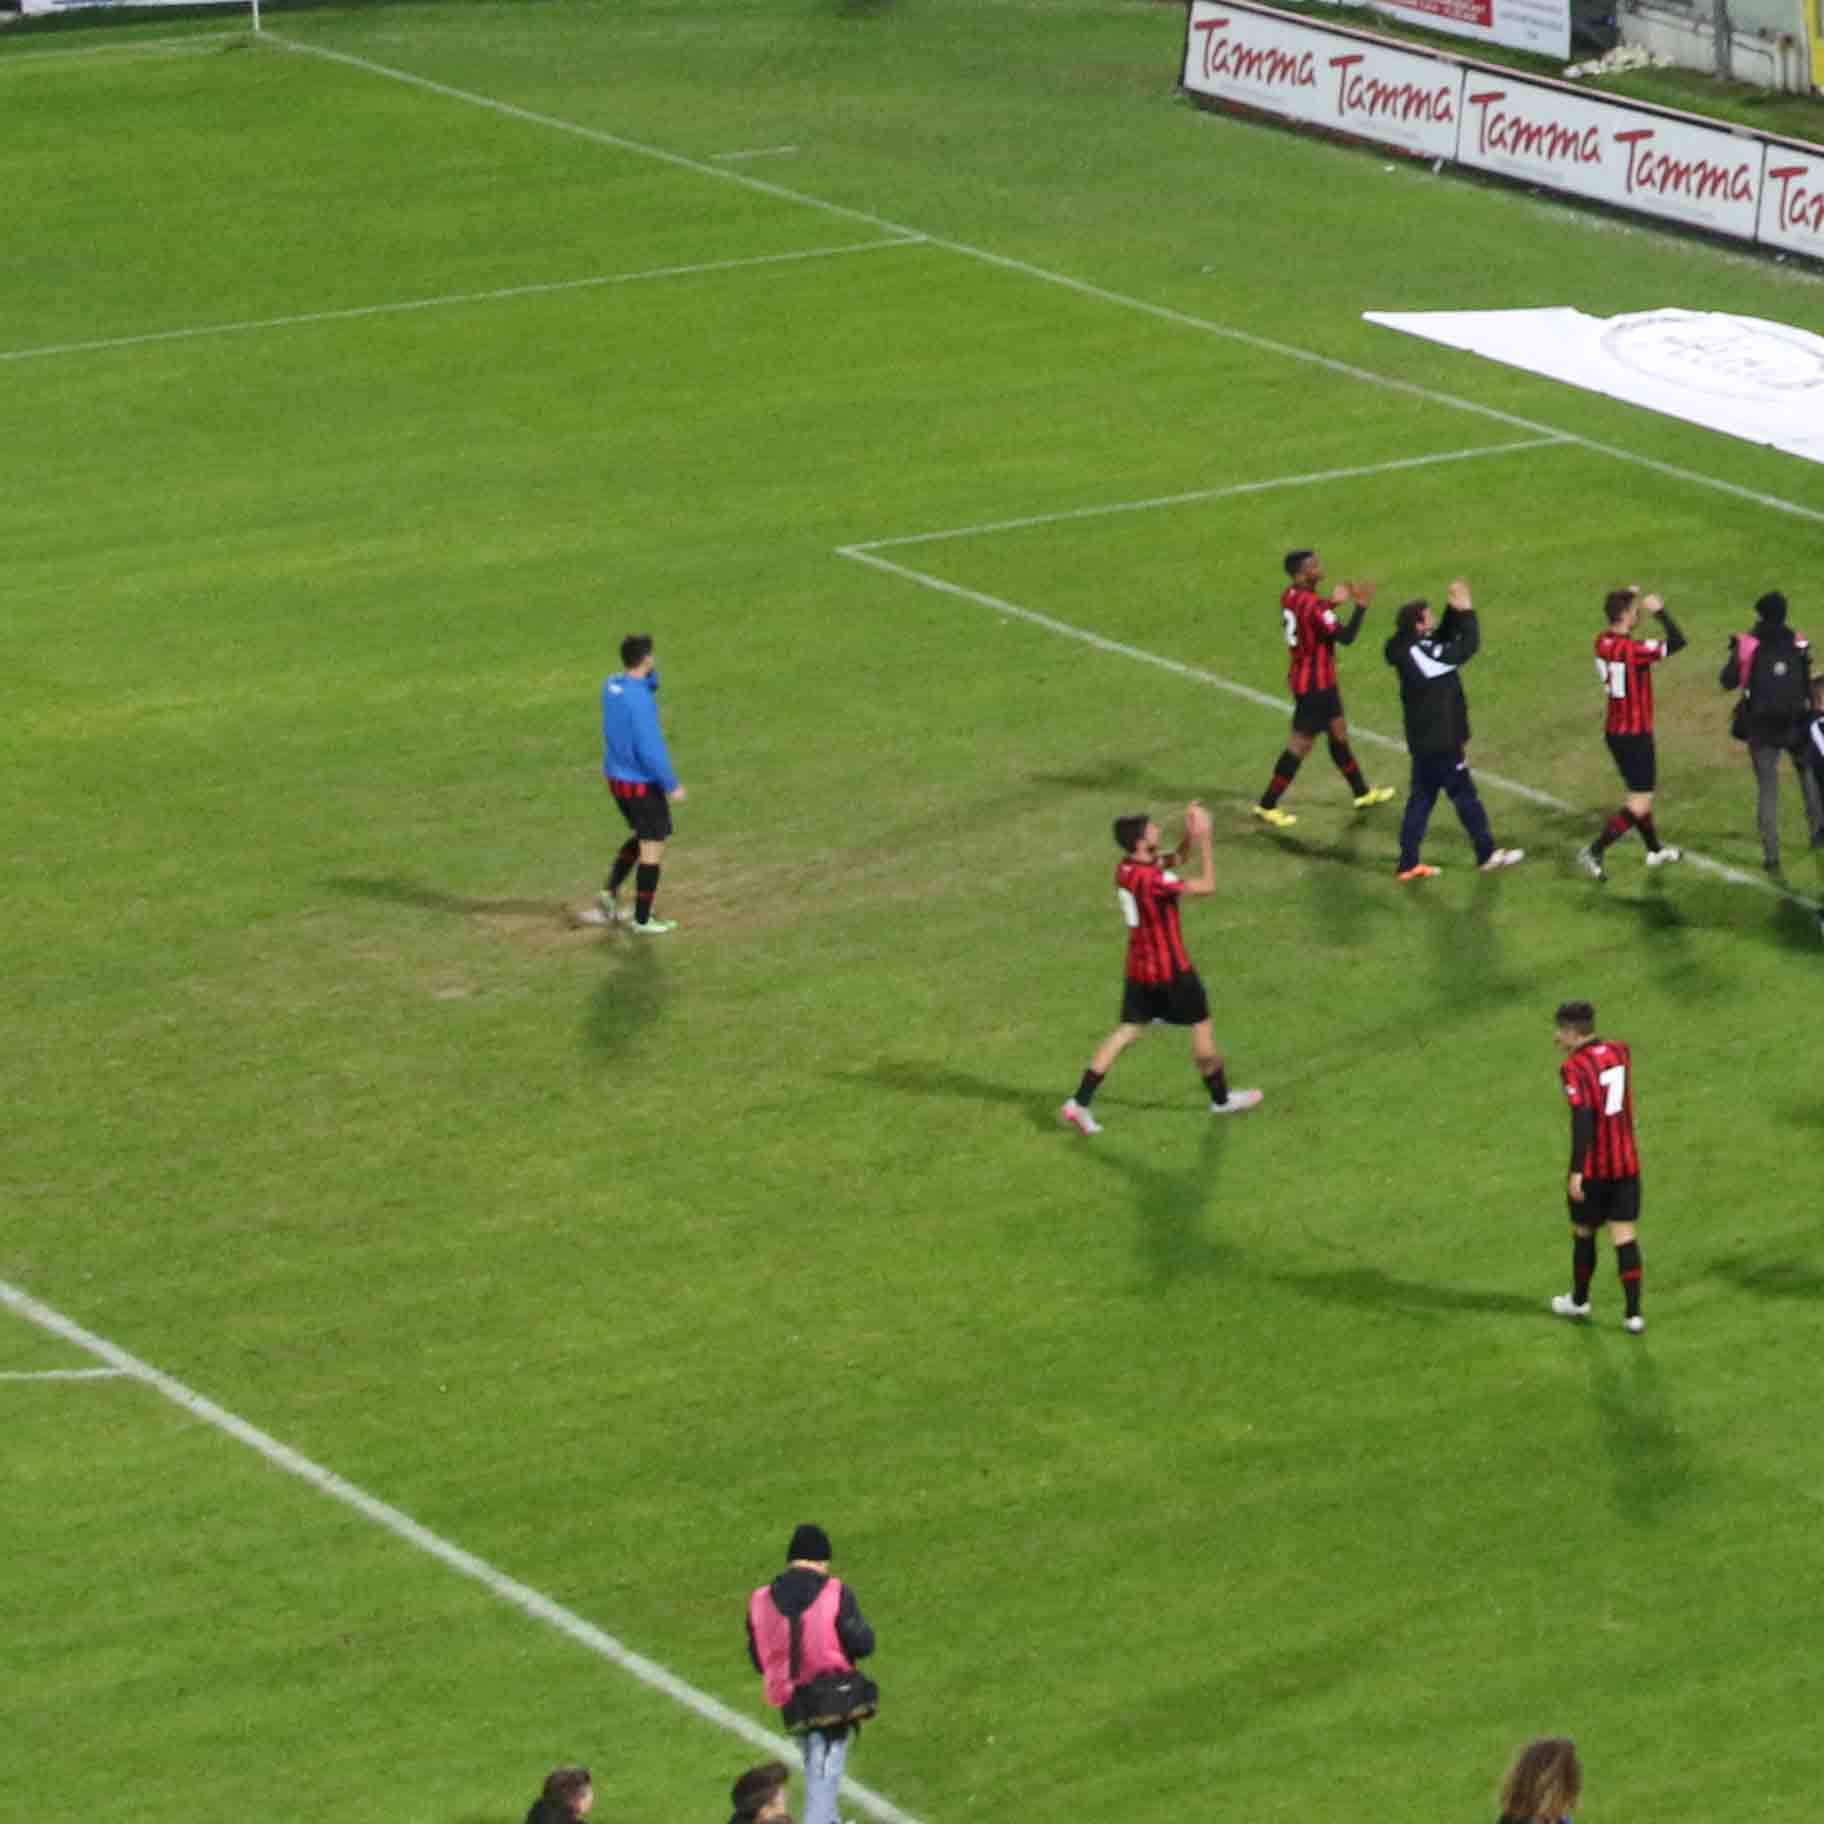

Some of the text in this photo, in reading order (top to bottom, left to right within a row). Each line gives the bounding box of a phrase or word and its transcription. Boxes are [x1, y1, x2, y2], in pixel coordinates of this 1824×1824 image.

[1195, 17, 1454, 125] Tamma Tamma
[1469, 93, 1754, 203] Tamma Tamma
[1599, 1064, 1626, 1116] 7
